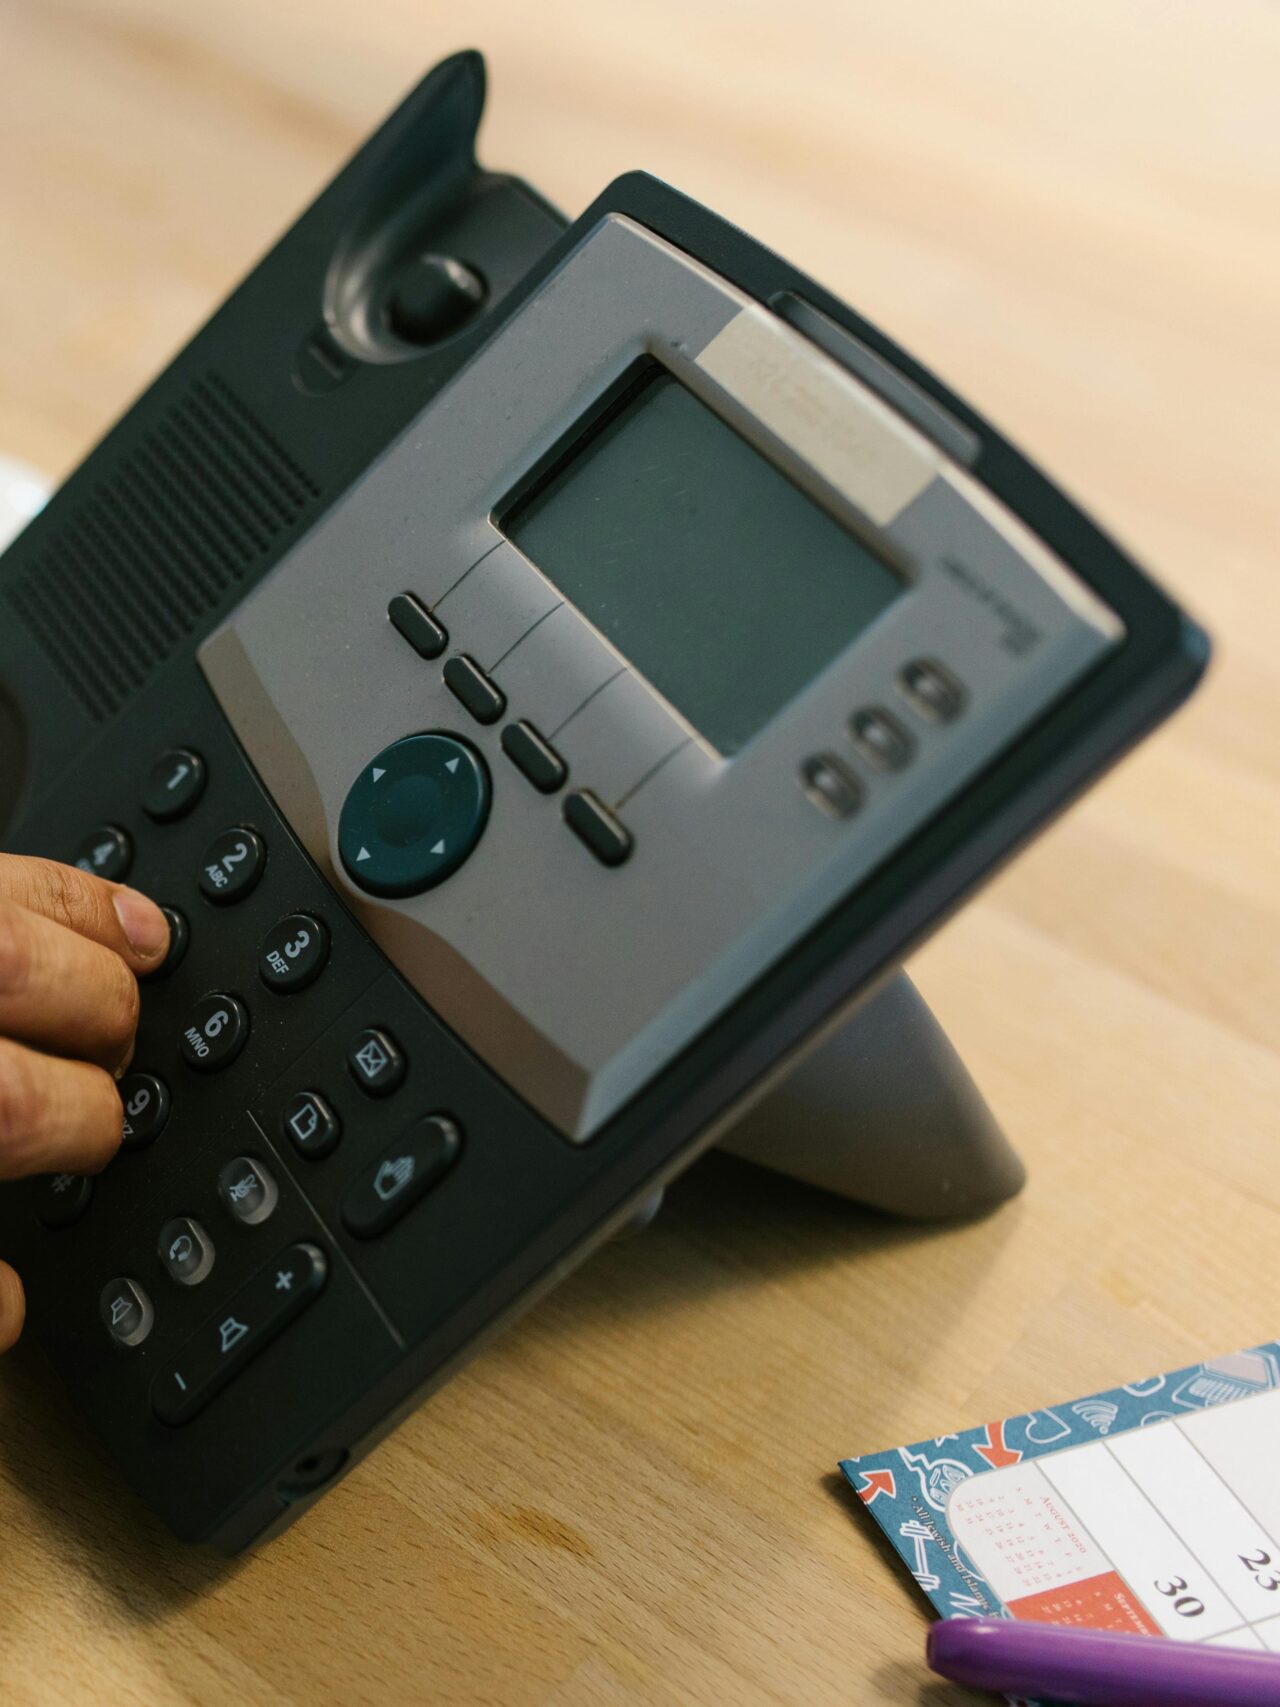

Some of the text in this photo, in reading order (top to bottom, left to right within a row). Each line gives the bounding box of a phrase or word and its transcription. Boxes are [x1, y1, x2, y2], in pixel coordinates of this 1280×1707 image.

[167, 764, 188, 790] 1
[93, 841, 115, 867] 4
[221, 842, 248, 873] 2
[204, 863, 228, 888] ABC
[284, 930, 310, 958] 3
[266, 950, 290, 974] DEF
[204, 1010, 229, 1037] 6
[183, 1026, 210, 1058] MNO
[127, 1088, 150, 1116] 9
[1040, 1495, 1088, 1554] AUGUST 2020
[912, 1504, 990, 1610] All Jewish and Islamic
[1237, 1548, 1280, 1591] 23
[1154, 1575, 1205, 1618] 30
